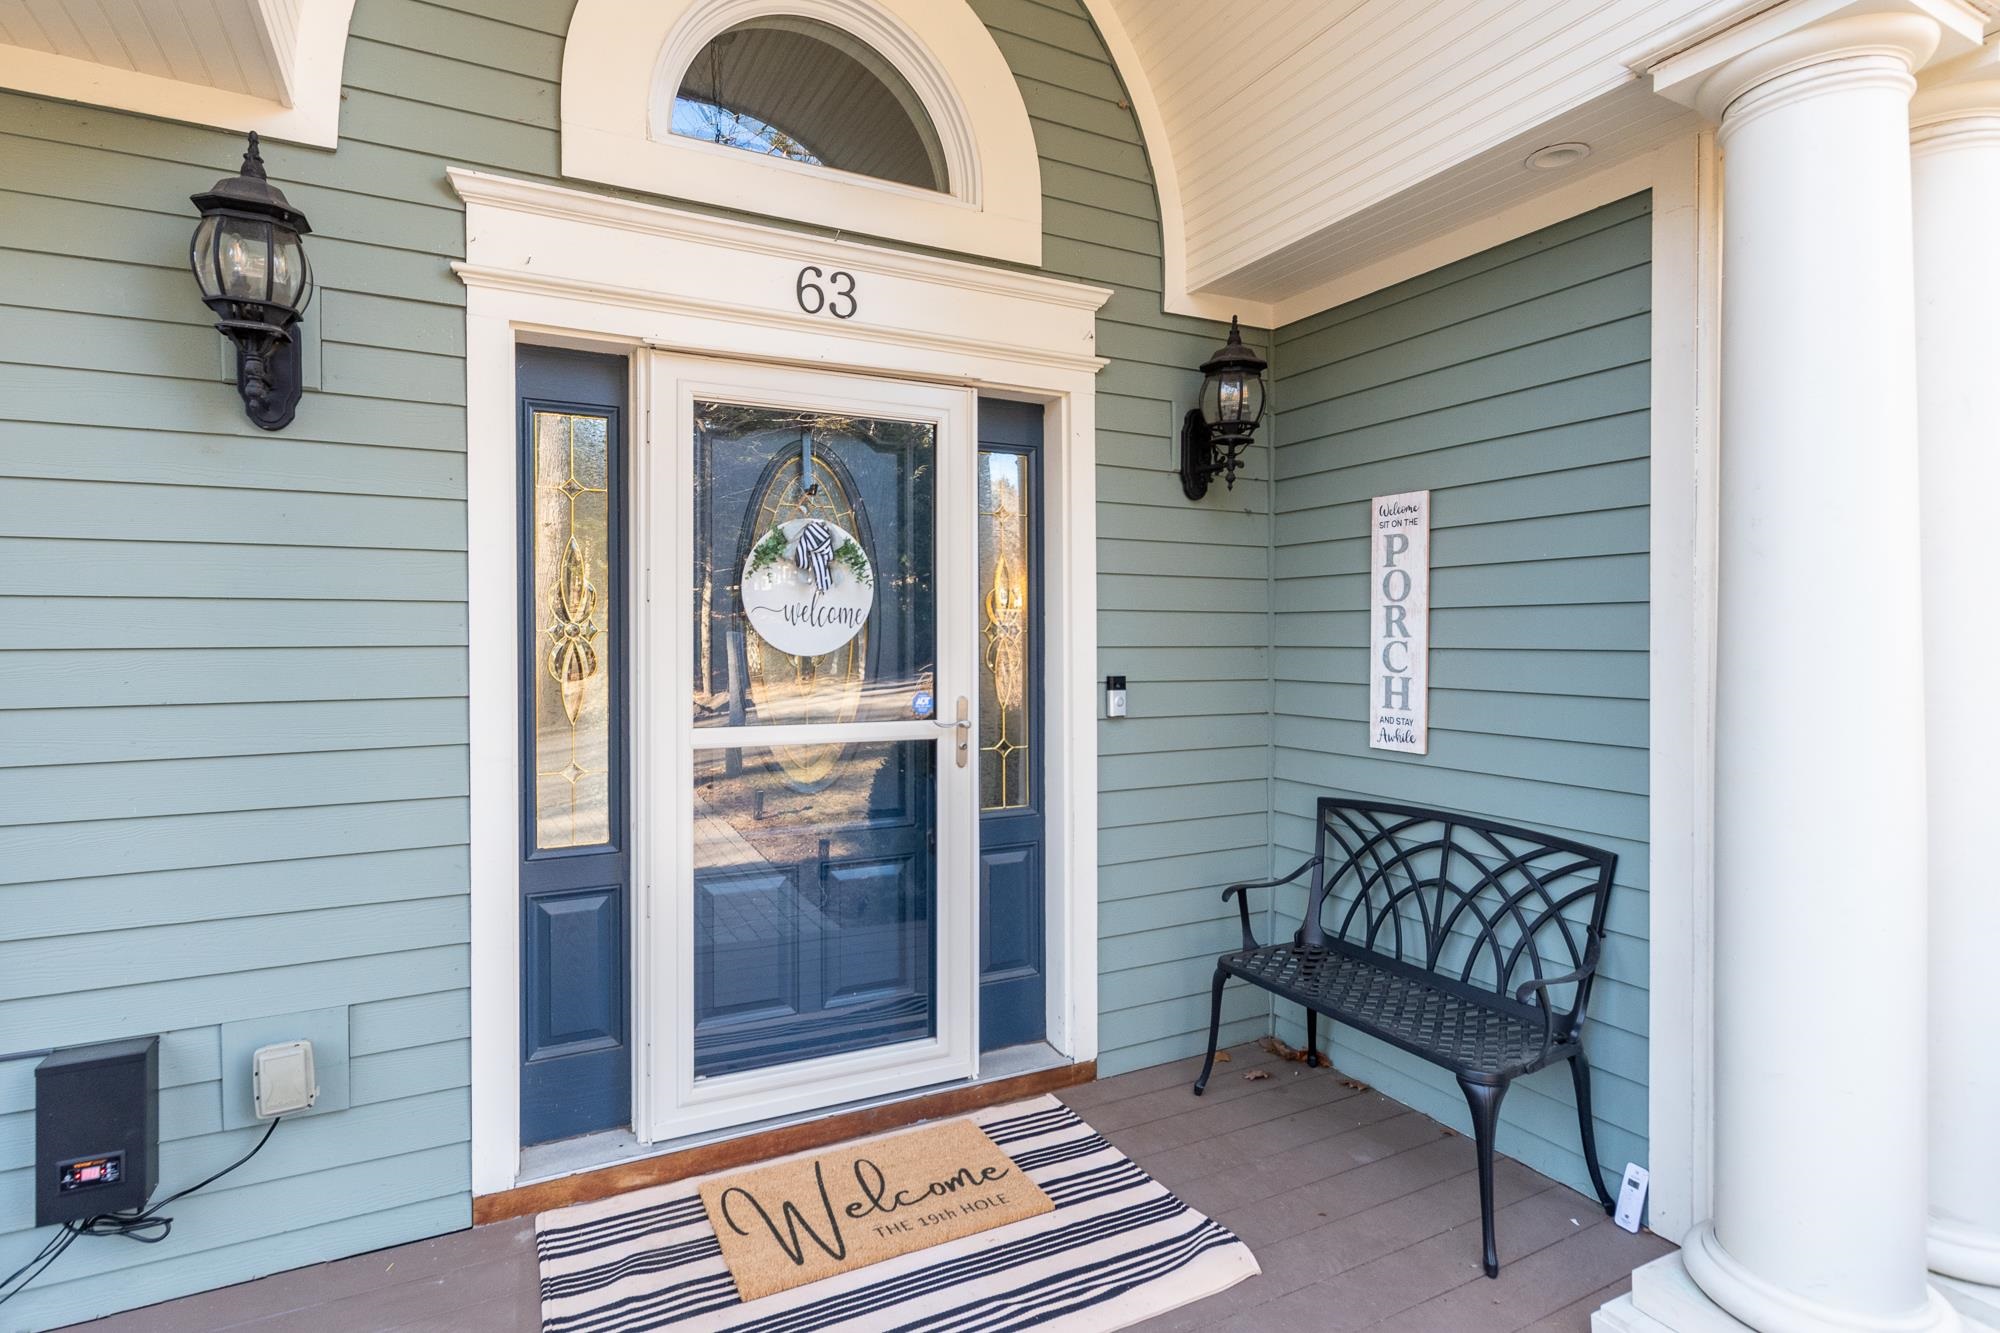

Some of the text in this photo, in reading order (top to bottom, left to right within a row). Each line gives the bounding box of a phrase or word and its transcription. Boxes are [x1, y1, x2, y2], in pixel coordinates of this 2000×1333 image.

[797, 266, 857, 319] 63
[1379, 501, 1419, 517] Welcome
[1379, 517, 1418, 529] SIT ON THE
[751, 590, 866, 629] welcome
[1382, 533, 1413, 711] PORCH
[1377, 727, 1416, 744] Awhile
[1380, 715, 1414, 727] AND STAY
[721, 1159, 1010, 1266] Welcome
[873, 1193, 1010, 1238] THE 19th HOLE
